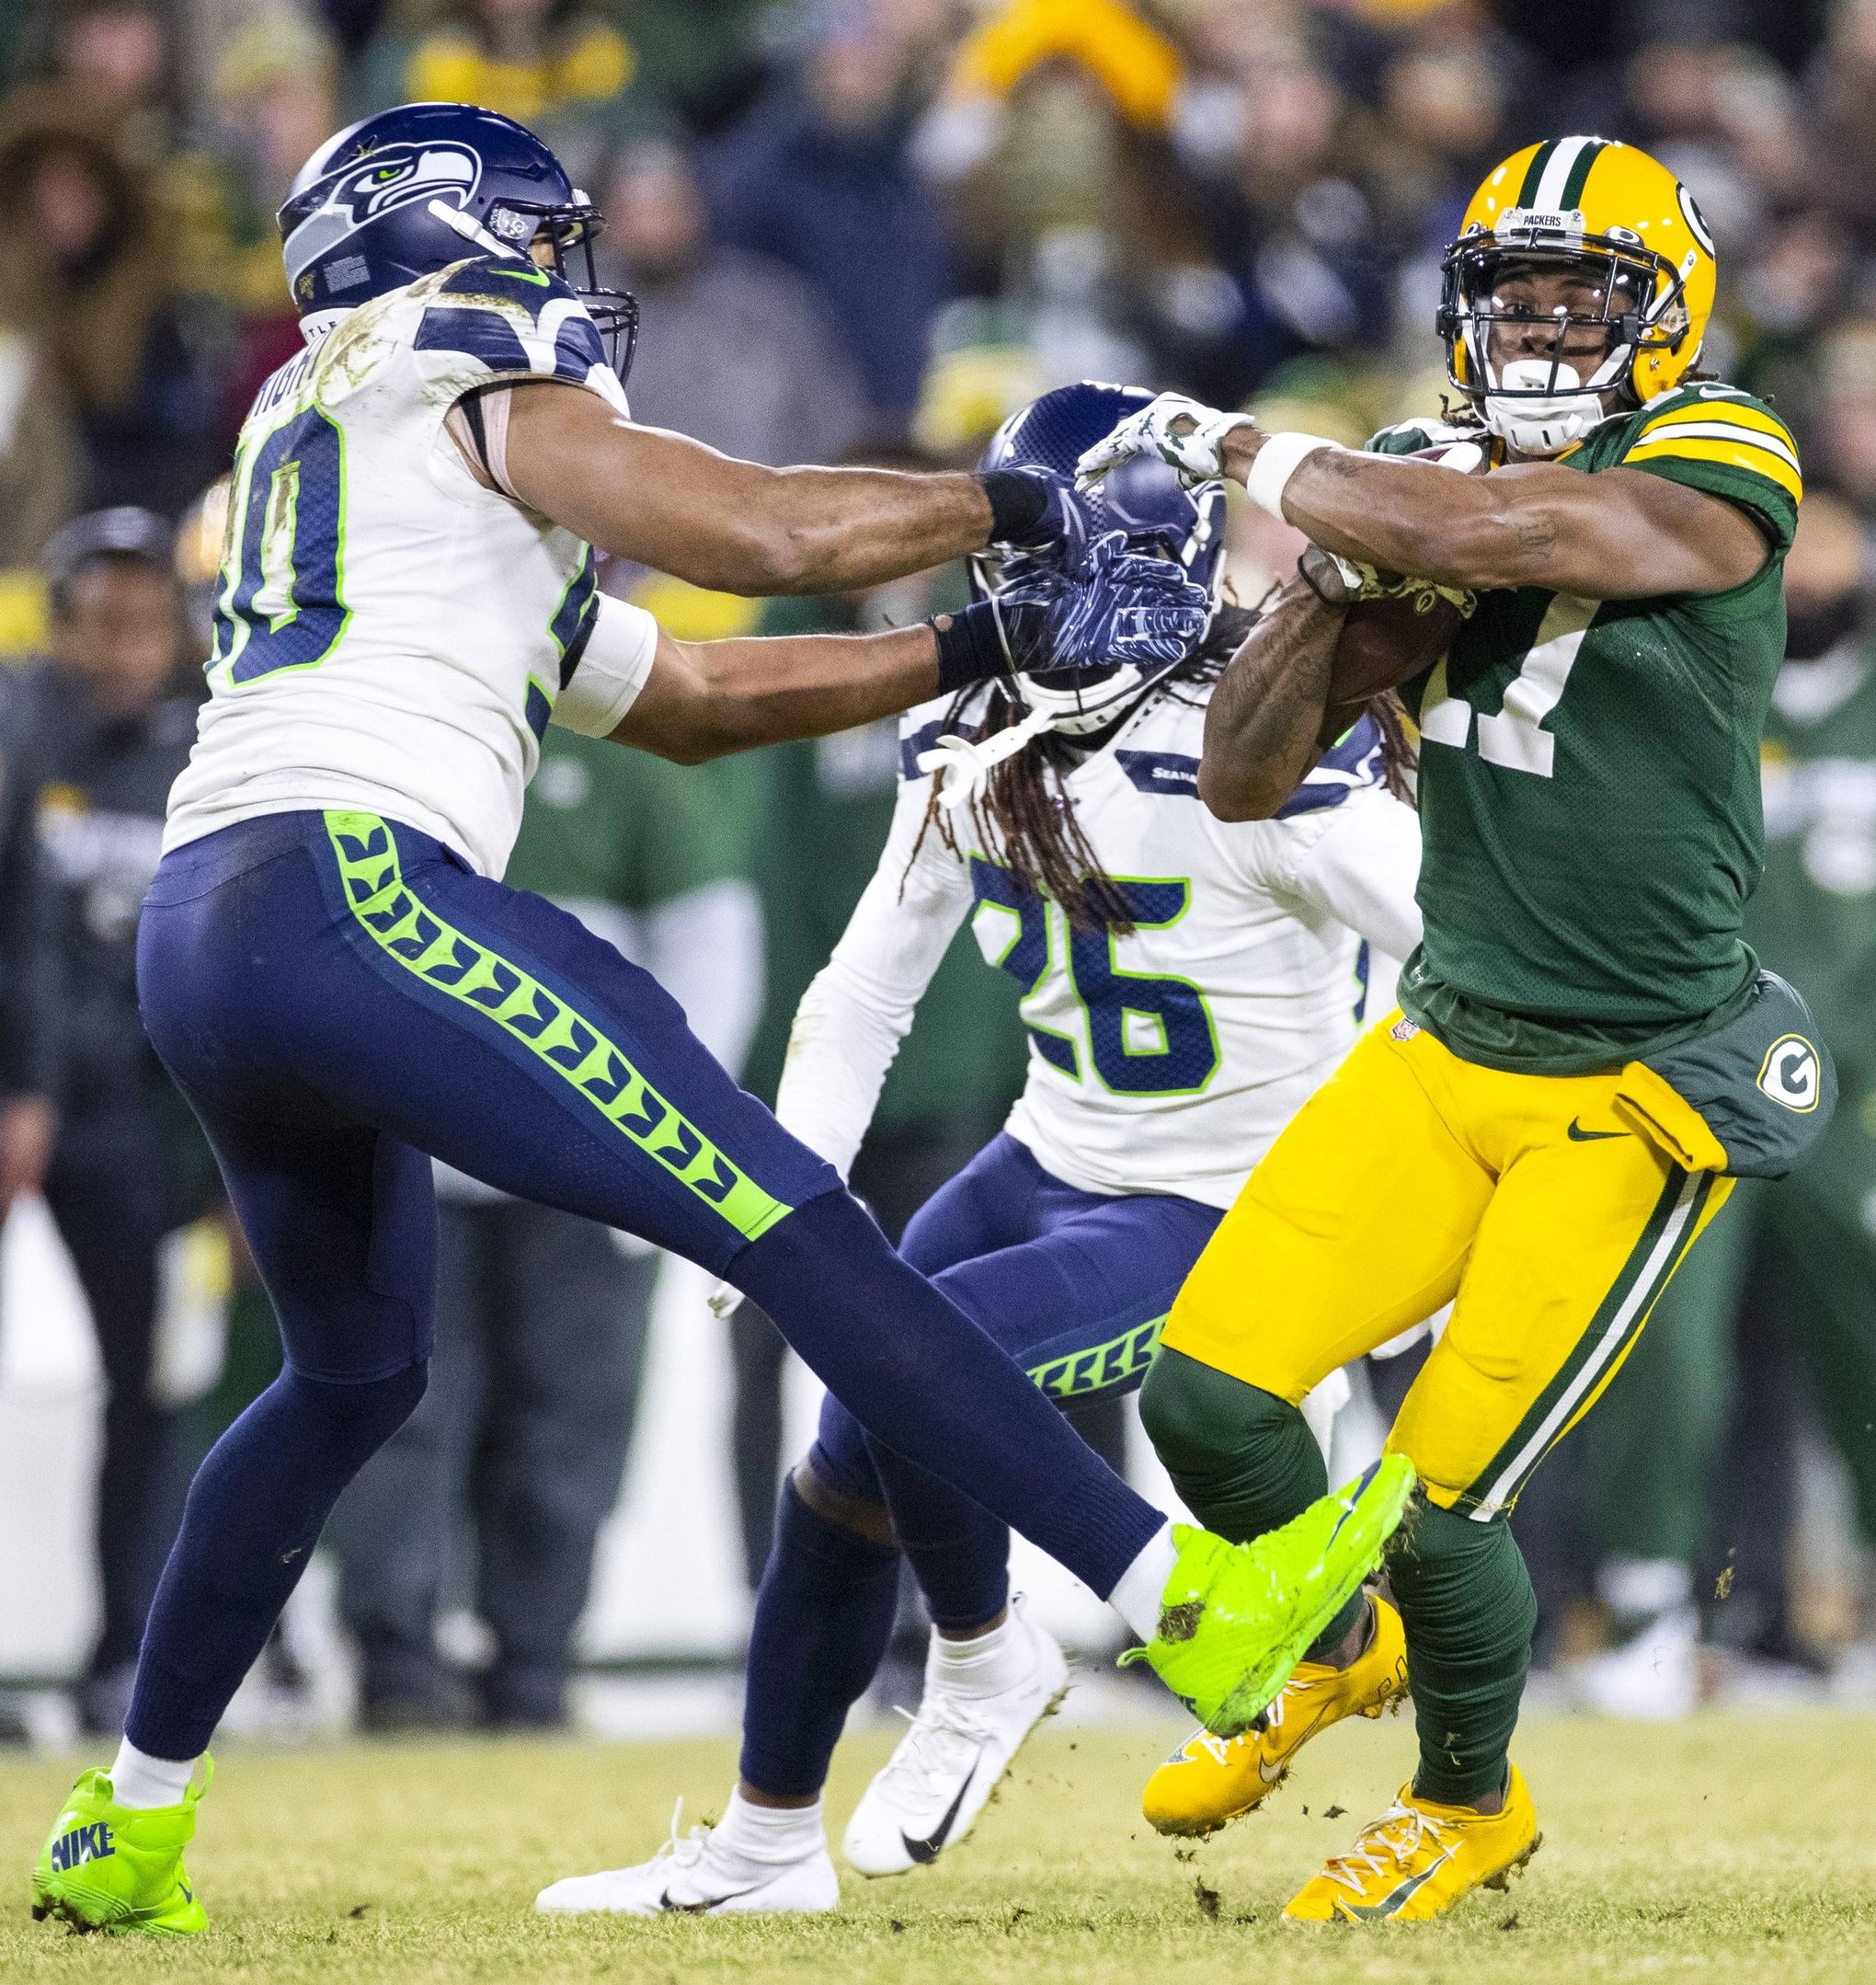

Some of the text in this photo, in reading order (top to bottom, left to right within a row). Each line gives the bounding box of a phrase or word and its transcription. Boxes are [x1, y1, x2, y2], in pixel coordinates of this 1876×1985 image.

[1523, 214, 1561, 227] PACKERS
[966, 844, 1222, 1098] 26
[1759, 1037, 1818, 1110] G
[51, 1821, 116, 1874] NIKE
